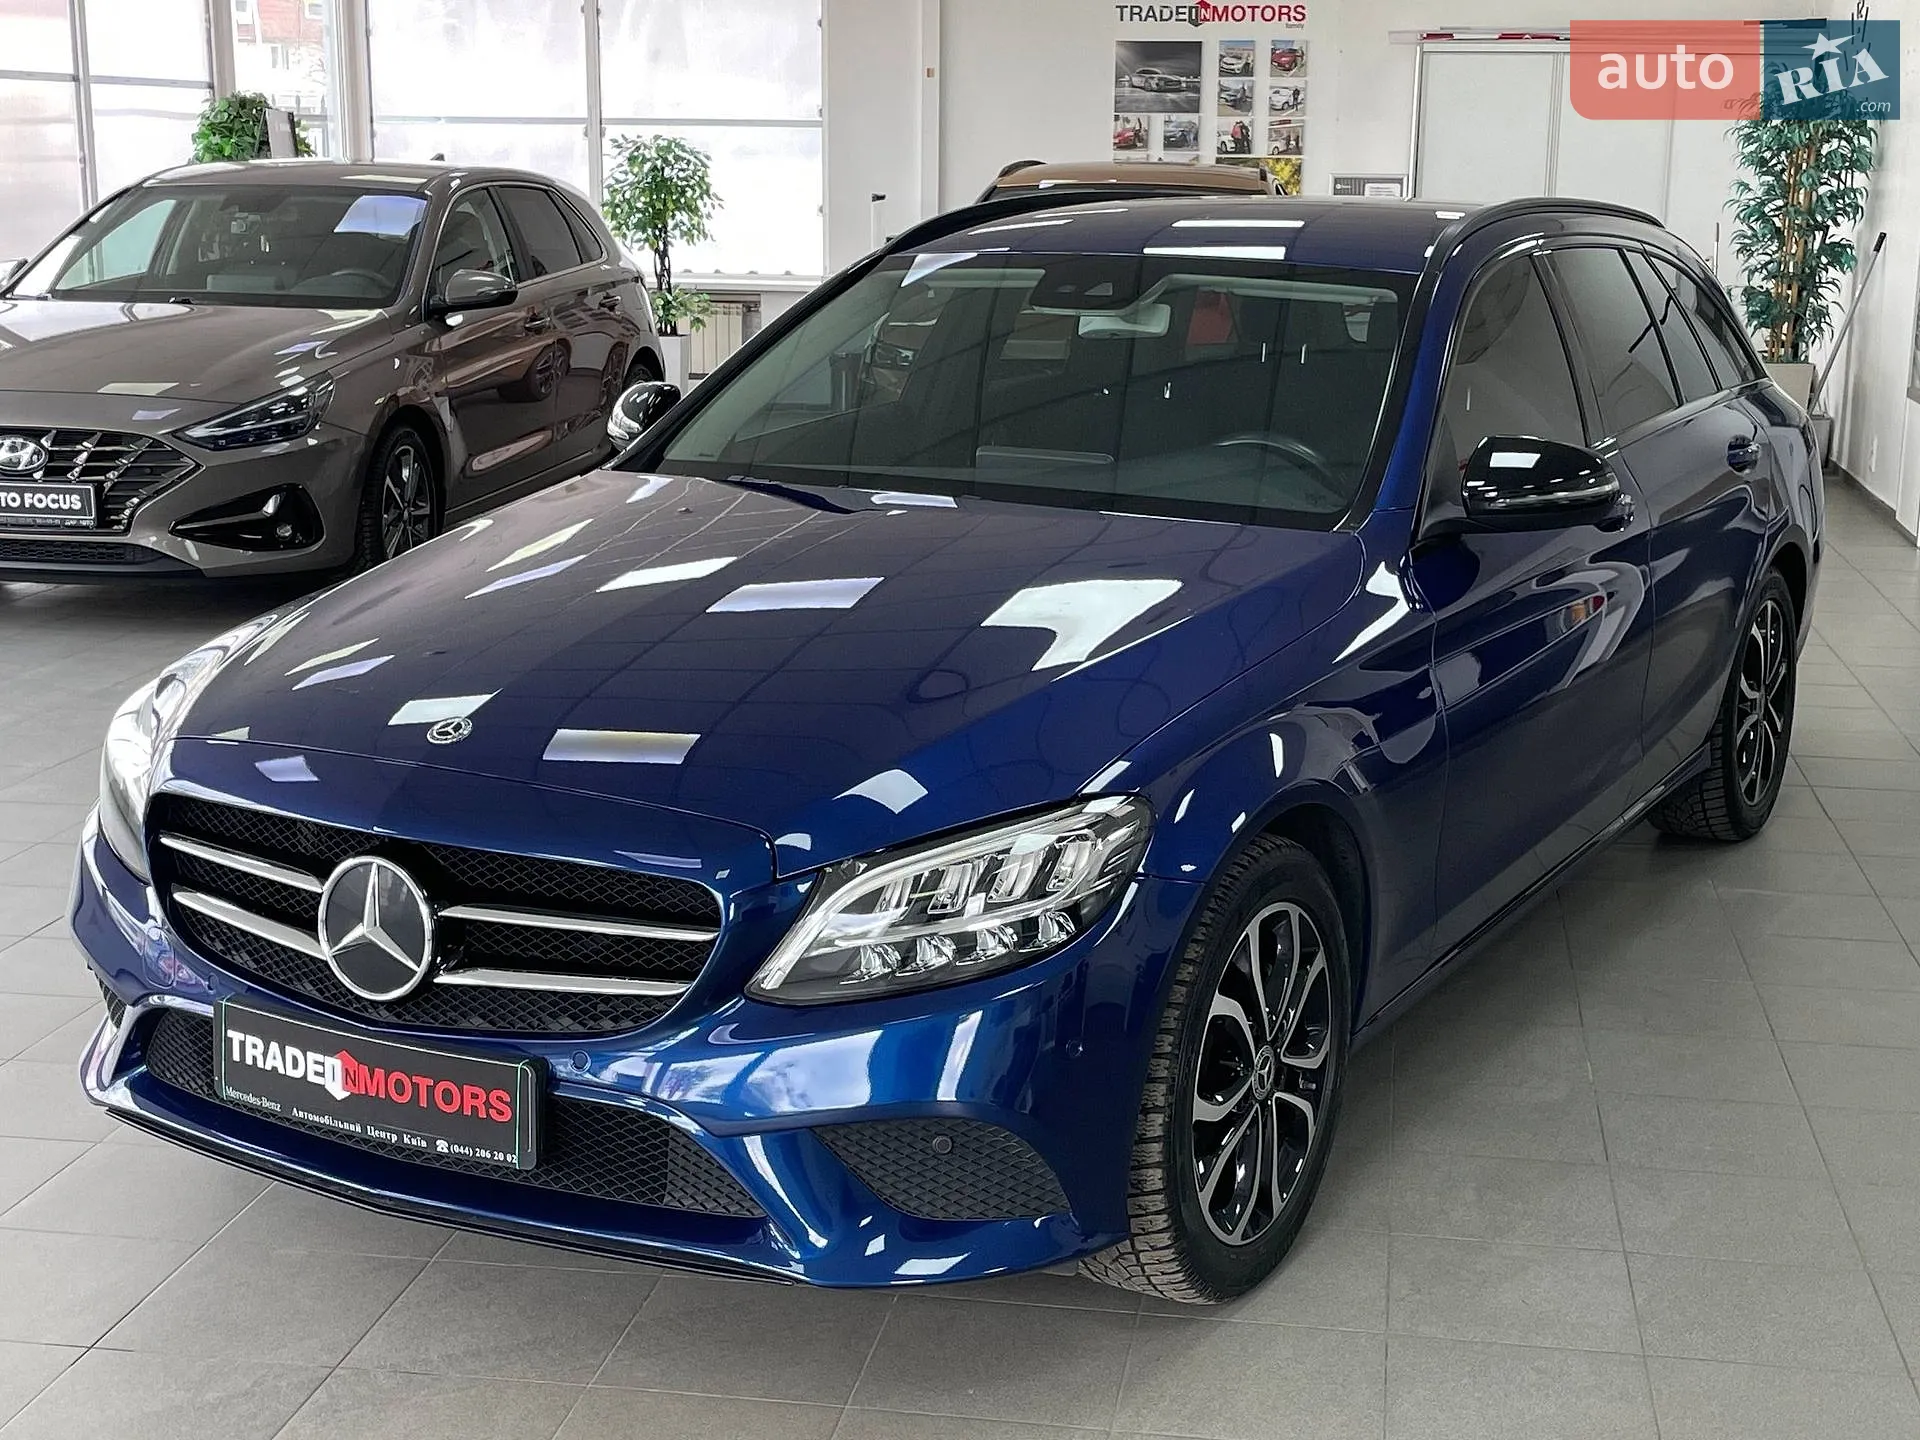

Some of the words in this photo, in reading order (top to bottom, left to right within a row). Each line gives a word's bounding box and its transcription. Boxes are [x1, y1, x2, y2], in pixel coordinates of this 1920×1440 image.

[23, 492, 82, 510] FOCUS
[226, 1085, 281, 1112] Mercedes-Benz
[291, 1107, 362, 1133] Автомобільний
[366, 1125, 398, 1144] Центр
[403, 1133, 428, 1148] Київ
[450, 1144, 473, 1158] (044)
[475, 1147, 491, 1159] 206
[493, 1150, 505, 1162] 20
[506, 1154, 518, 1164] 02
